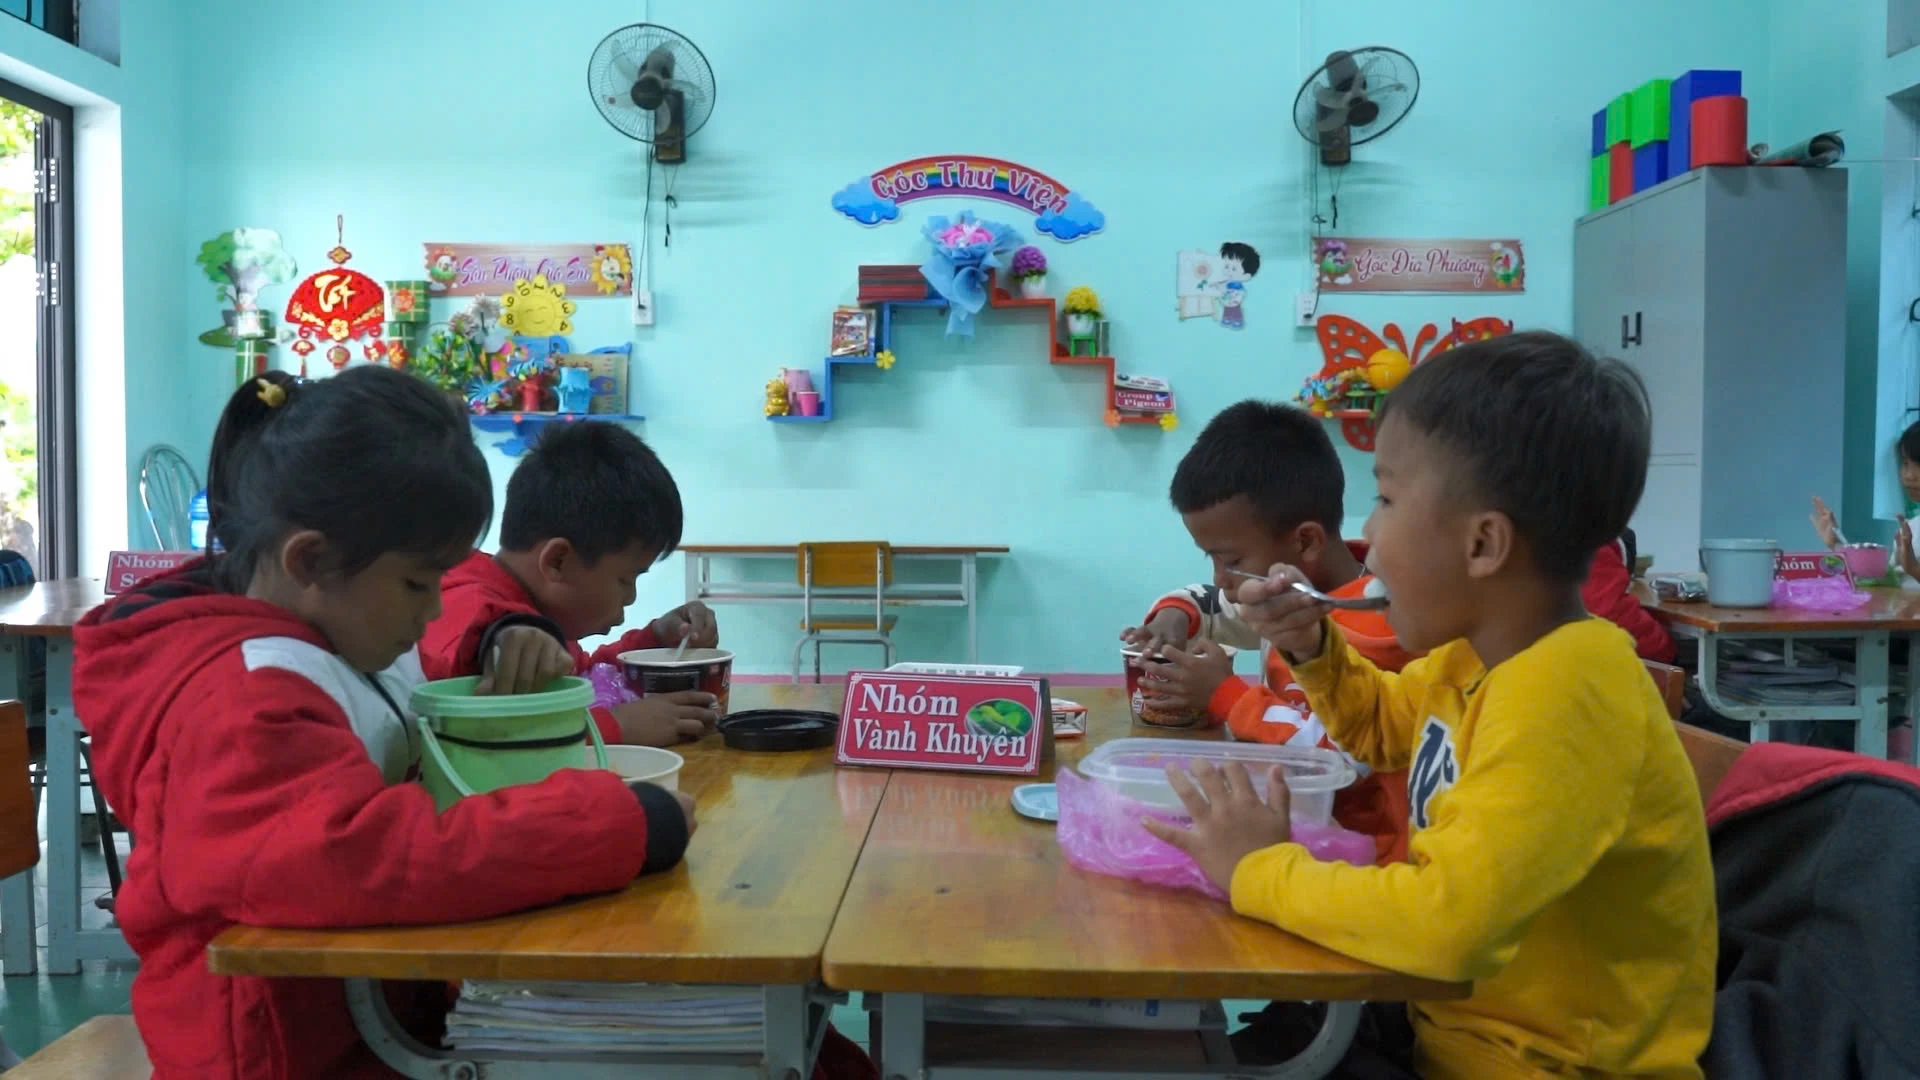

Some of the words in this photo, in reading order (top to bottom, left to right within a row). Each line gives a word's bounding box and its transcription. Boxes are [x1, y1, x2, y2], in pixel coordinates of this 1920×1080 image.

[872, 169, 928, 199] Góc
[936, 161, 996, 188] Thư
[1008, 168, 1069, 214] Viện
[506, 313, 514, 325] 8
[117, 555, 174, 569] Nhóm
[858, 683, 959, 717] Nhóm
[853, 717, 917, 752] Vành
[924, 722, 1027, 763] Khuyên
